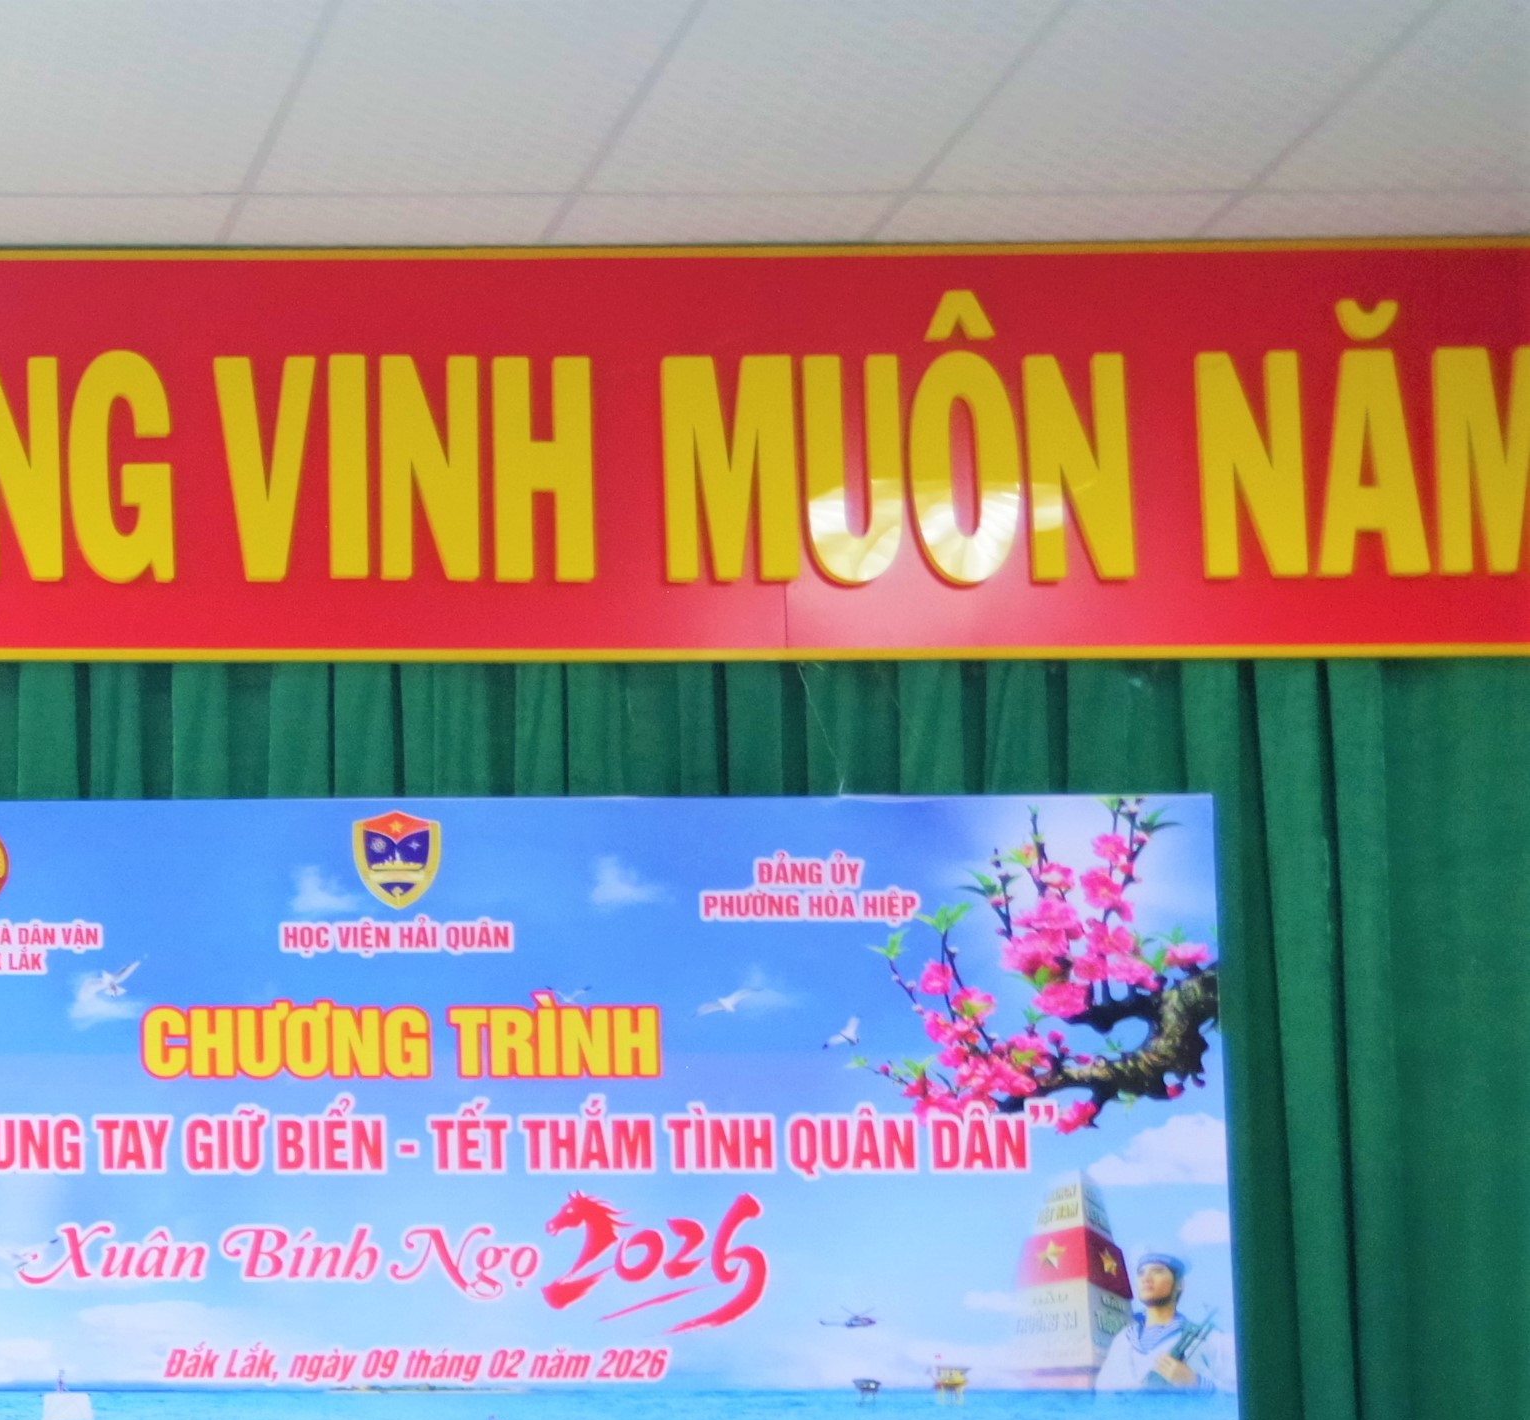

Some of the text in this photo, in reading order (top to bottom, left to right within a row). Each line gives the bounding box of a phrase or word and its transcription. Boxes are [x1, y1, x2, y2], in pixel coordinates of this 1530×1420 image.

[213, 354, 593, 582] VINH
[660, 289, 1136, 585] MUÔN
[1194, 298, 1530, 580] NĂM
[757, 853, 861, 885] ĐẢNG ỦY
[703, 887, 917, 922] PHƯỜNG HÒA HIỆP
[18, 922, 56, 946] DÂN
[62, 922, 98, 950] VẬN
[283, 916, 511, 952] HỌC VIỆN HẢI QUÂN
[8, 946, 42, 971] LẮK
[141, 992, 661, 1080] CHƯƠNG TRÌNH
[95, 1118, 171, 1171] TAY
[185, 1107, 269, 1171] GIỮ
[276, 1096, 384, 1171] BIỂN
[430, 1097, 508, 1171] TẾT
[522, 1095, 652, 1171] THẮM
[668, 1104, 773, 1171] TÌNH
[790, 1106, 915, 1175] QUÂN
[18, 1190, 768, 1334] Xuân Bính Ngọ 2026
[164, 1342, 666, 1383] Đắk Lắk, ngày 09 tháng 02 năm 2026
